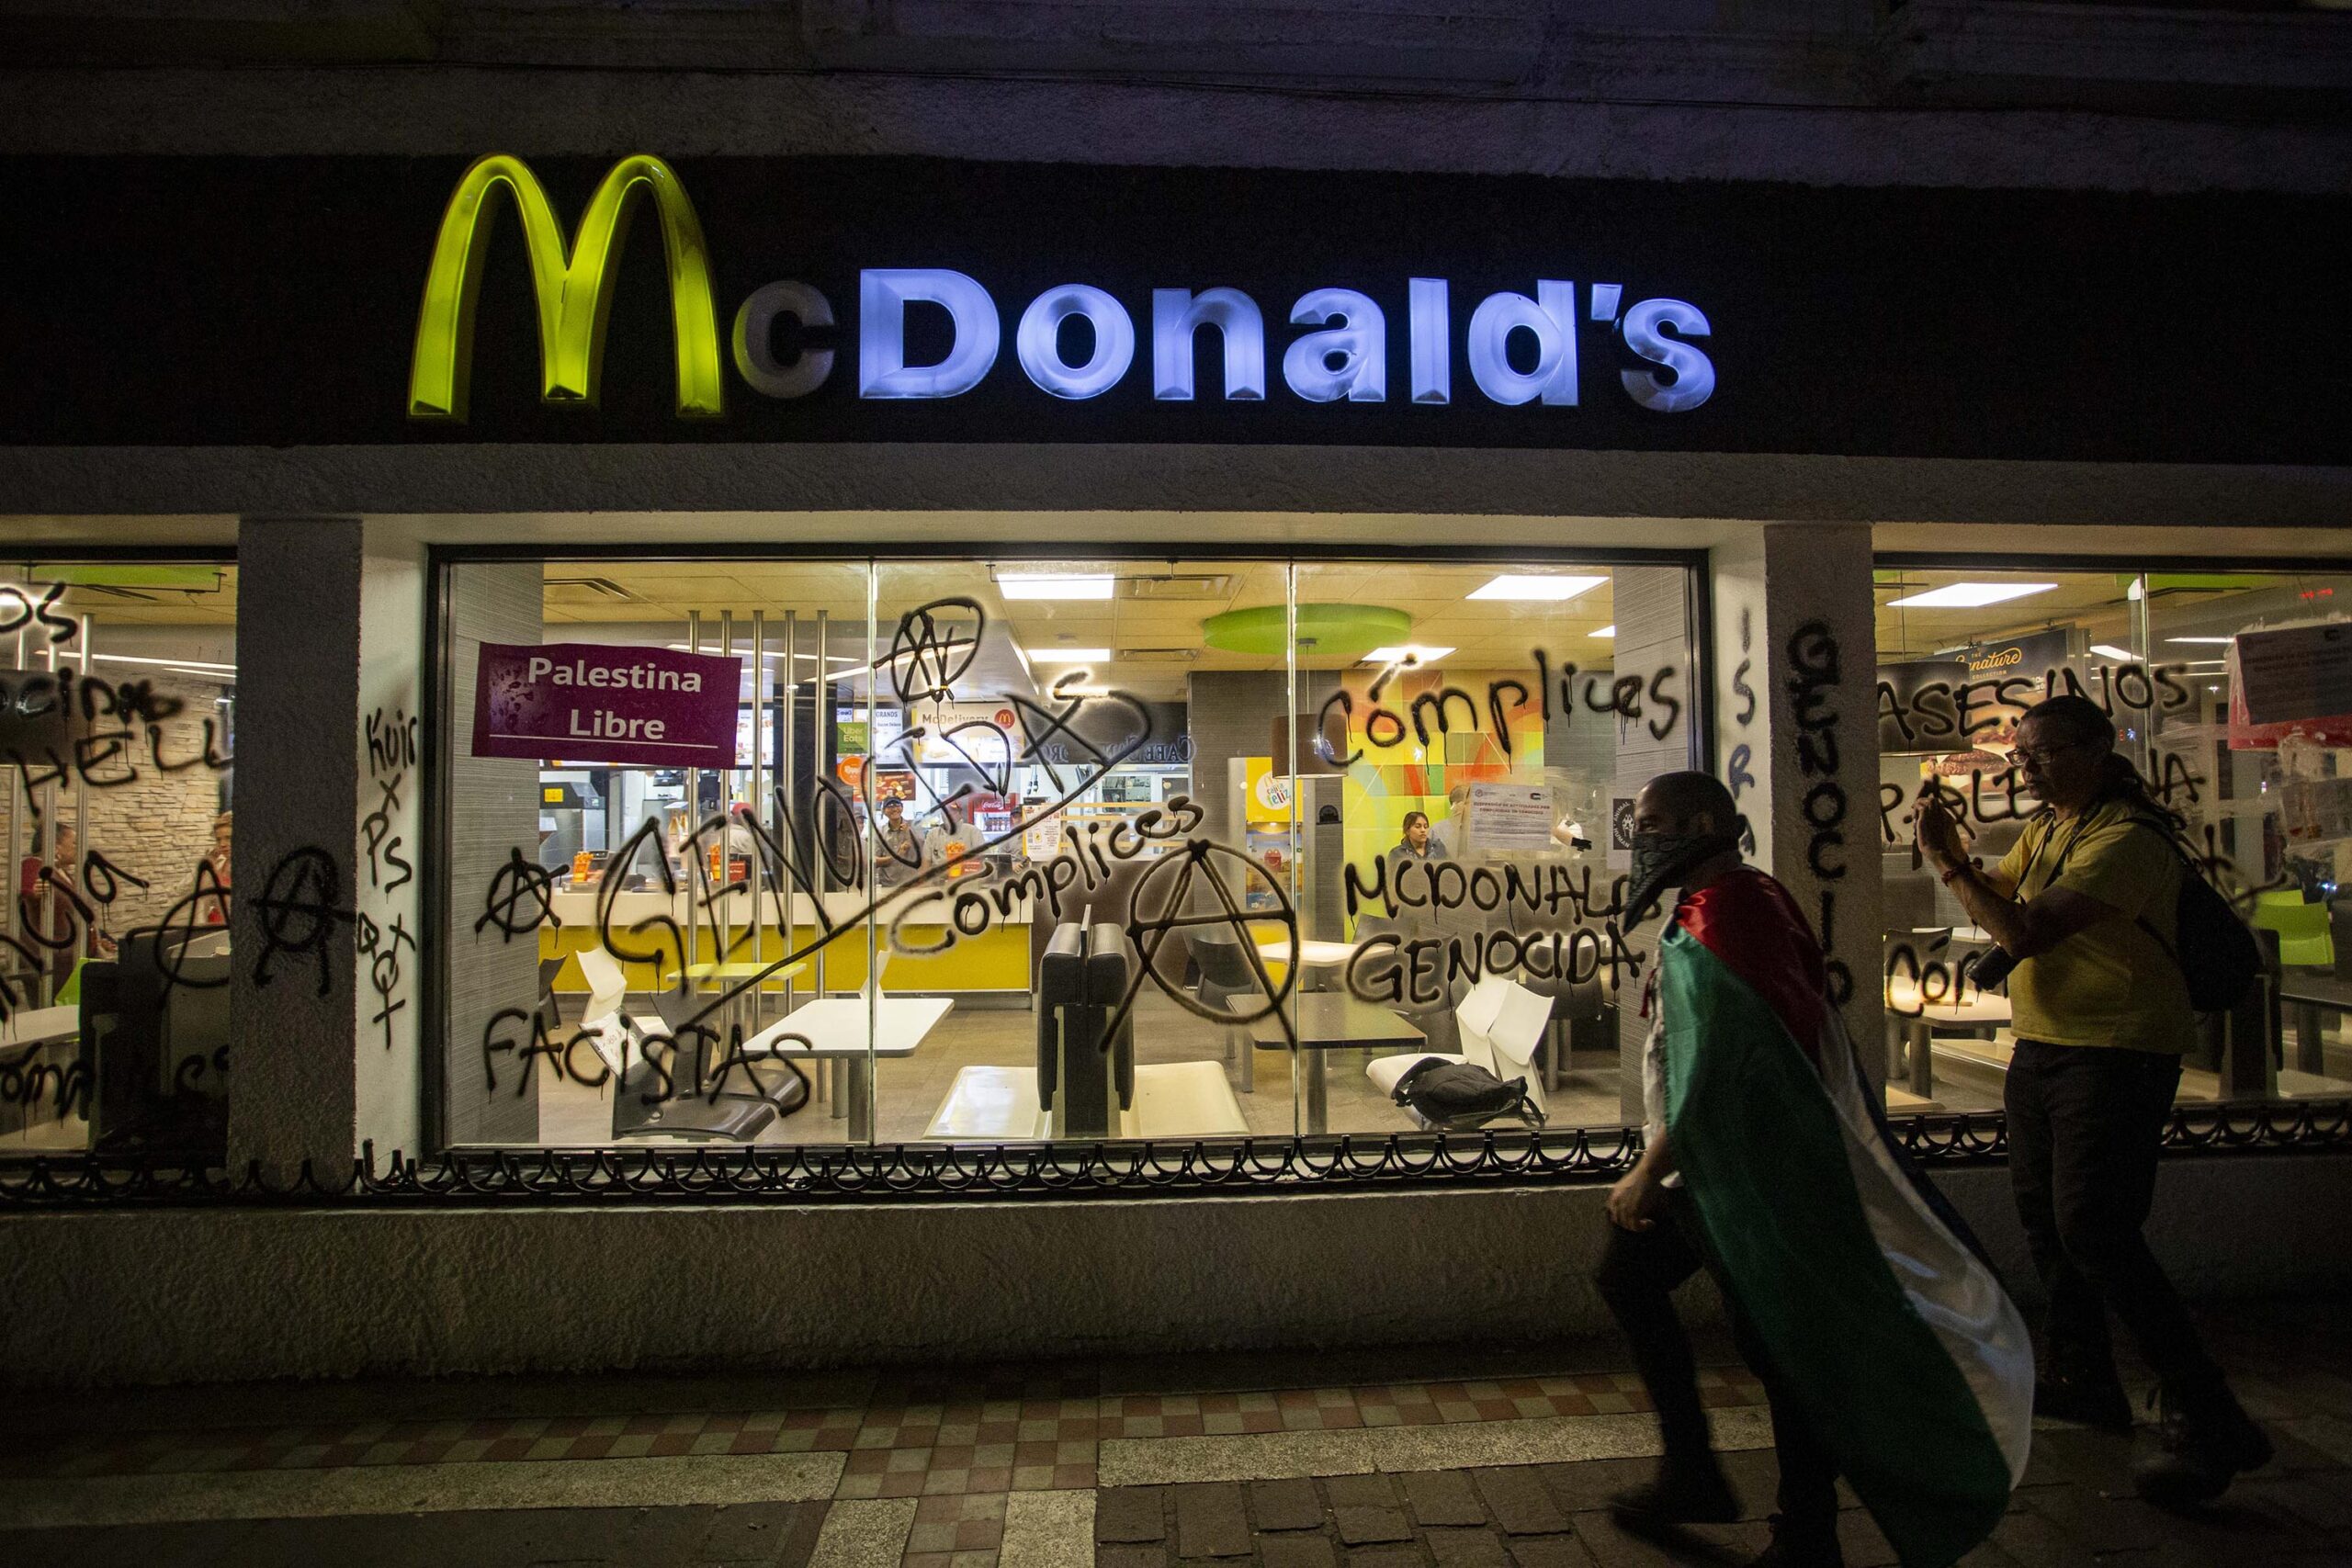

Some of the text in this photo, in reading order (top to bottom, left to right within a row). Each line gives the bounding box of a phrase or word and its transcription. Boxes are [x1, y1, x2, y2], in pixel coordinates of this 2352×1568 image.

[409, 154, 1716, 421] McDonald's
[528, 657, 702, 694] Palestina
[1877, 662, 2187, 739] ASESINOS
[570, 708, 665, 739] Libre
[922, 713, 989, 724] McDelivery
[482, 1009, 813, 1118] FACISTAS
